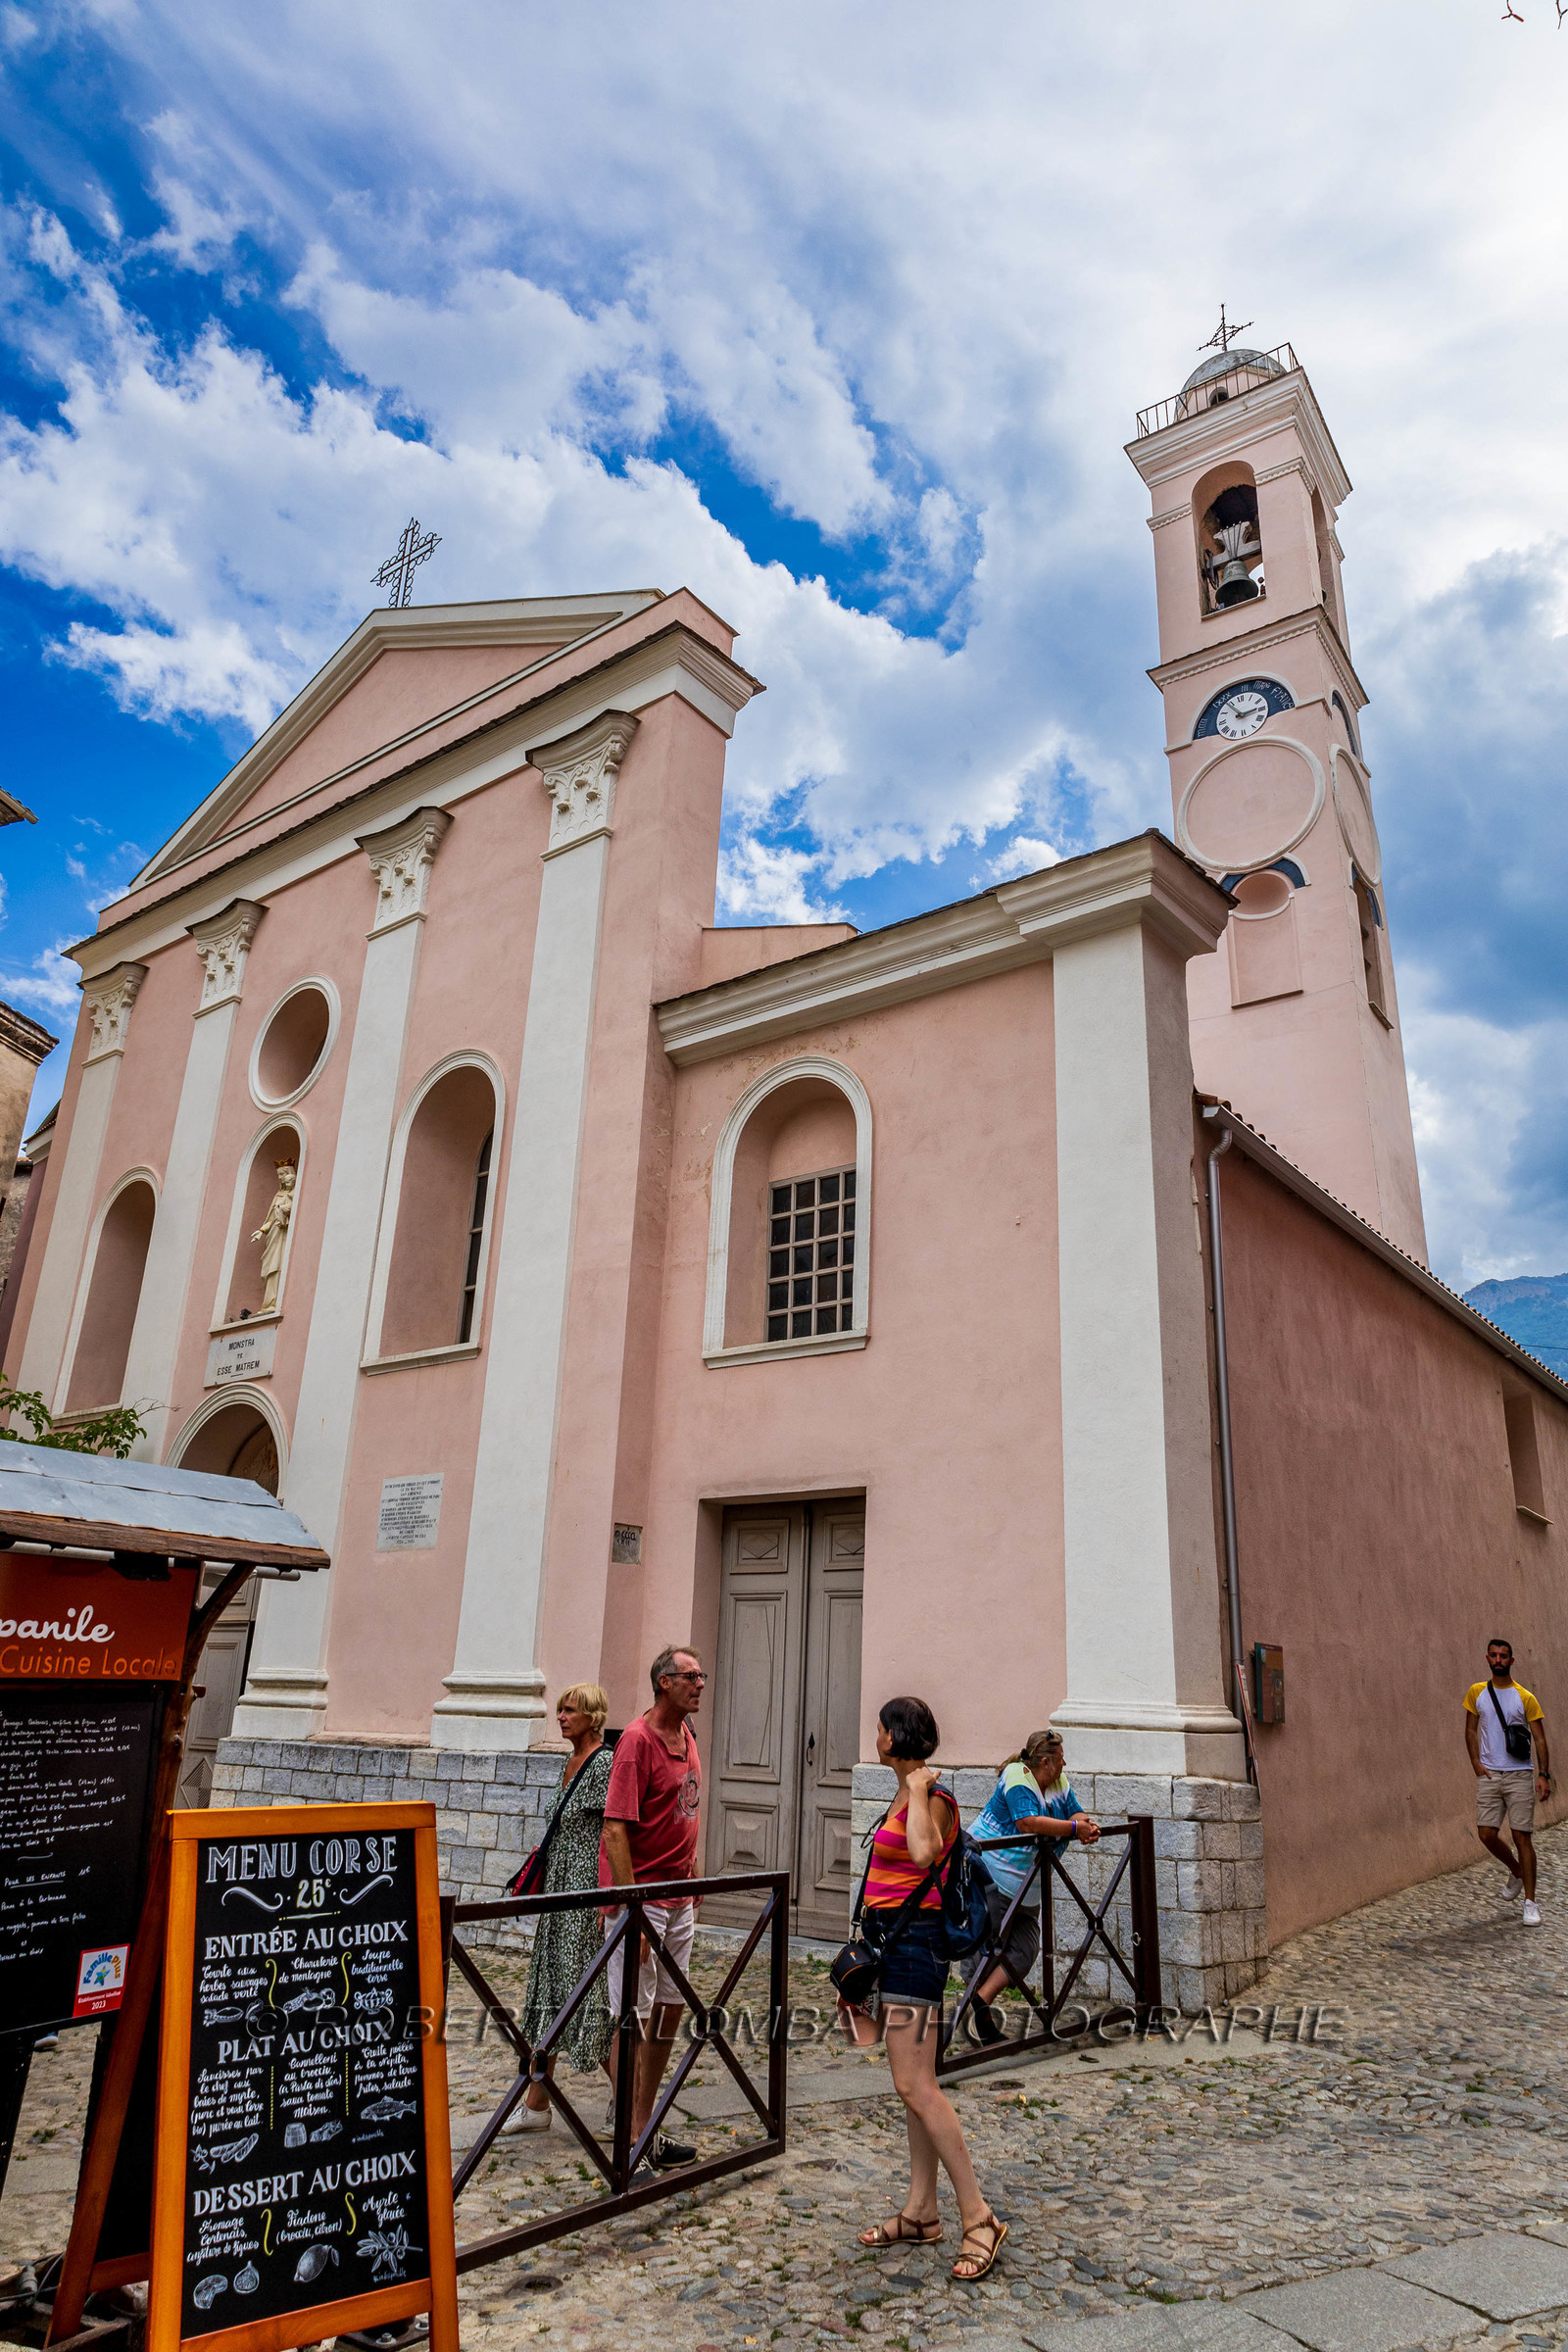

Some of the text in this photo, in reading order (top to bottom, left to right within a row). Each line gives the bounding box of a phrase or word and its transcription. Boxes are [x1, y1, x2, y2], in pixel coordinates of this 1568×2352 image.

[227, 1338, 255, 1351] MONSTRA
[217, 1359, 261, 1377] ESSE MATREM
[0, 1644, 177, 1676] Cuisine Locale
[205, 1836, 398, 1884] MENU CORSE
[296, 1878, 332, 1909] 25€
[204, 1920, 409, 1960] ENTRÉE AU CHOIX
[83, 1951, 113, 1984] Famille
[237, 1967, 258, 1977] aux
[351, 1958, 404, 1976] traditionnelle
[199, 1977, 269, 1993] herbes sauvages
[278, 1969, 332, 1984] de montagne
[200, 1986, 259, 2004] salade verte
[91, 1999, 107, 2011] 2023
[217, 2021, 392, 2065] PLAT AU CHOIX
[245, 2067, 264, 2080] par
[354, 2060, 364, 2071] à
[367, 2059, 376, 2069] la
[284, 2071, 297, 2082] au
[354, 2071, 384, 2086] pommes
[387, 2068, 397, 2078] de
[200, 2082, 210, 2094] le
[212, 2080, 229, 2095] chef
[307, 2087, 334, 2103] tomate
[217, 2093, 227, 2105] de
[216, 2105, 224, 2118] et
[193, 2149, 417, 2218] DESSERT AU CHOIX
[198, 2216, 245, 2235] Fromage
[287, 2208, 327, 2229] Fiadone
[222, 2241, 232, 2254] de
[232, 2239, 260, 2258] figues
